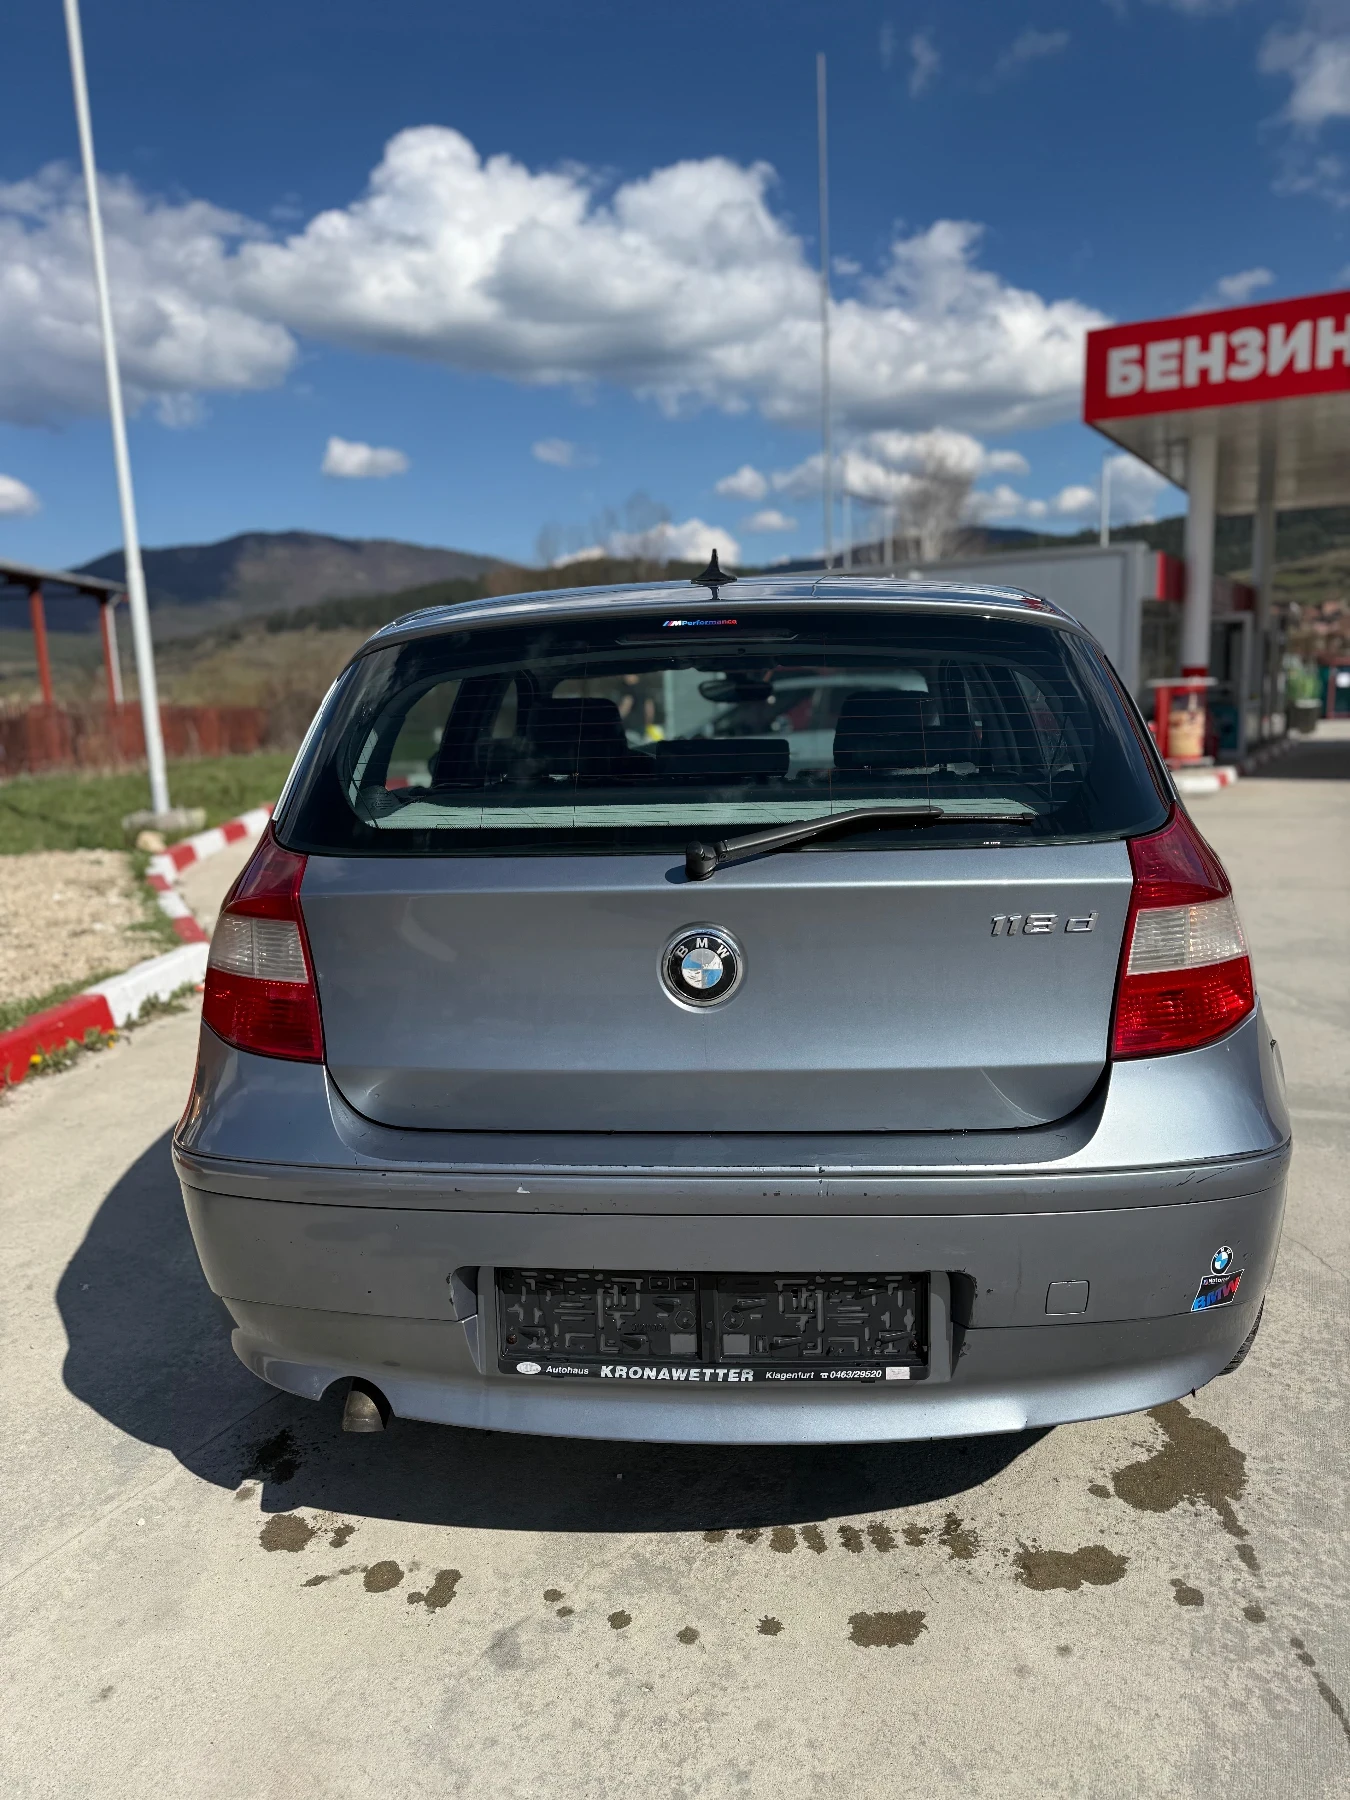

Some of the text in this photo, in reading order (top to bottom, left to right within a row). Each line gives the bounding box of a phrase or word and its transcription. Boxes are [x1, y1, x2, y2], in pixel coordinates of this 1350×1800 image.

[1105, 313, 1350, 398] БЕНЗИН
[990, 911, 1099, 936] 118 d
[676, 937, 730, 959] BMW
[545, 1365, 589, 1375] Autohaus
[600, 1365, 754, 1382] KRONAWETTER
[765, 1371, 814, 1380] Klagenfurt
[829, 1370, 883, 1379] 0463/29520
